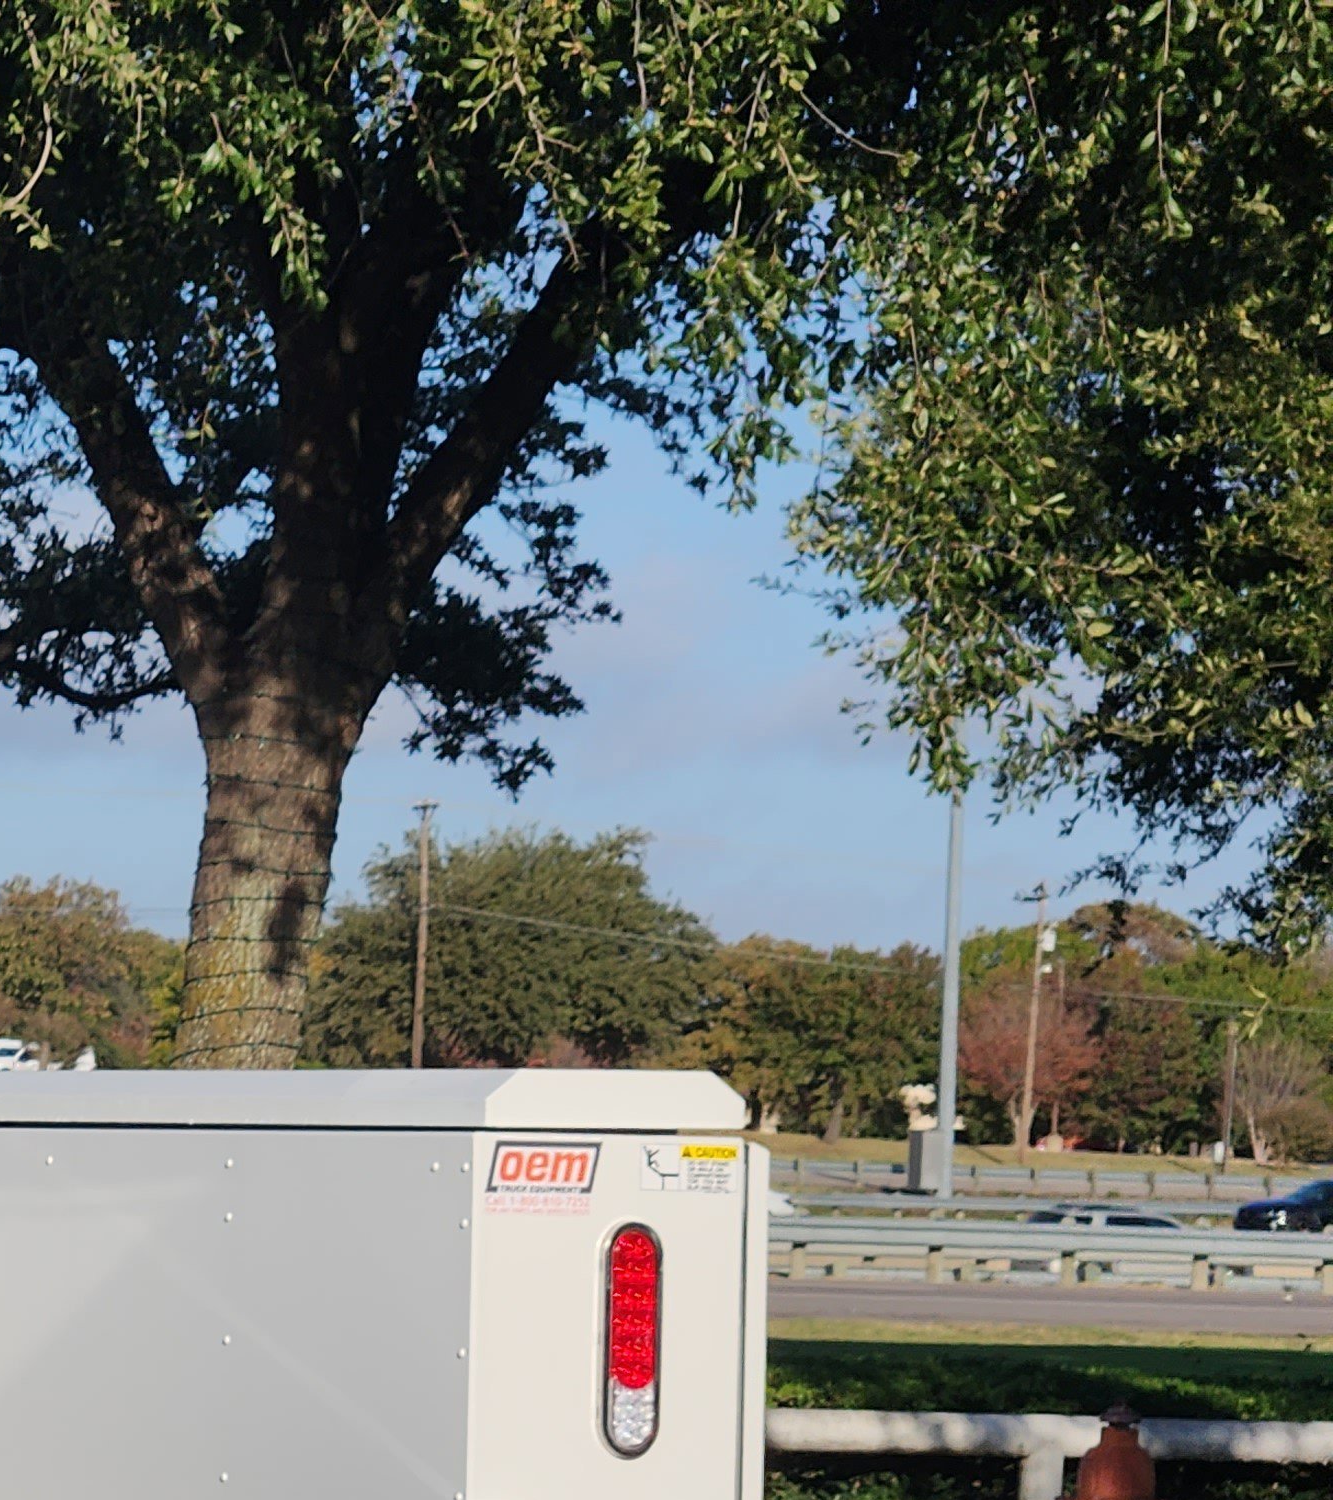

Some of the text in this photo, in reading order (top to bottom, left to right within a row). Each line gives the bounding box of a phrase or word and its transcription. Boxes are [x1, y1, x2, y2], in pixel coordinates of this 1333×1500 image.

[695, 1146, 737, 1159] CAUTION
[500, 1150, 590, 1182] oem
[529, 1185, 579, 1194] EQUIPMENT
